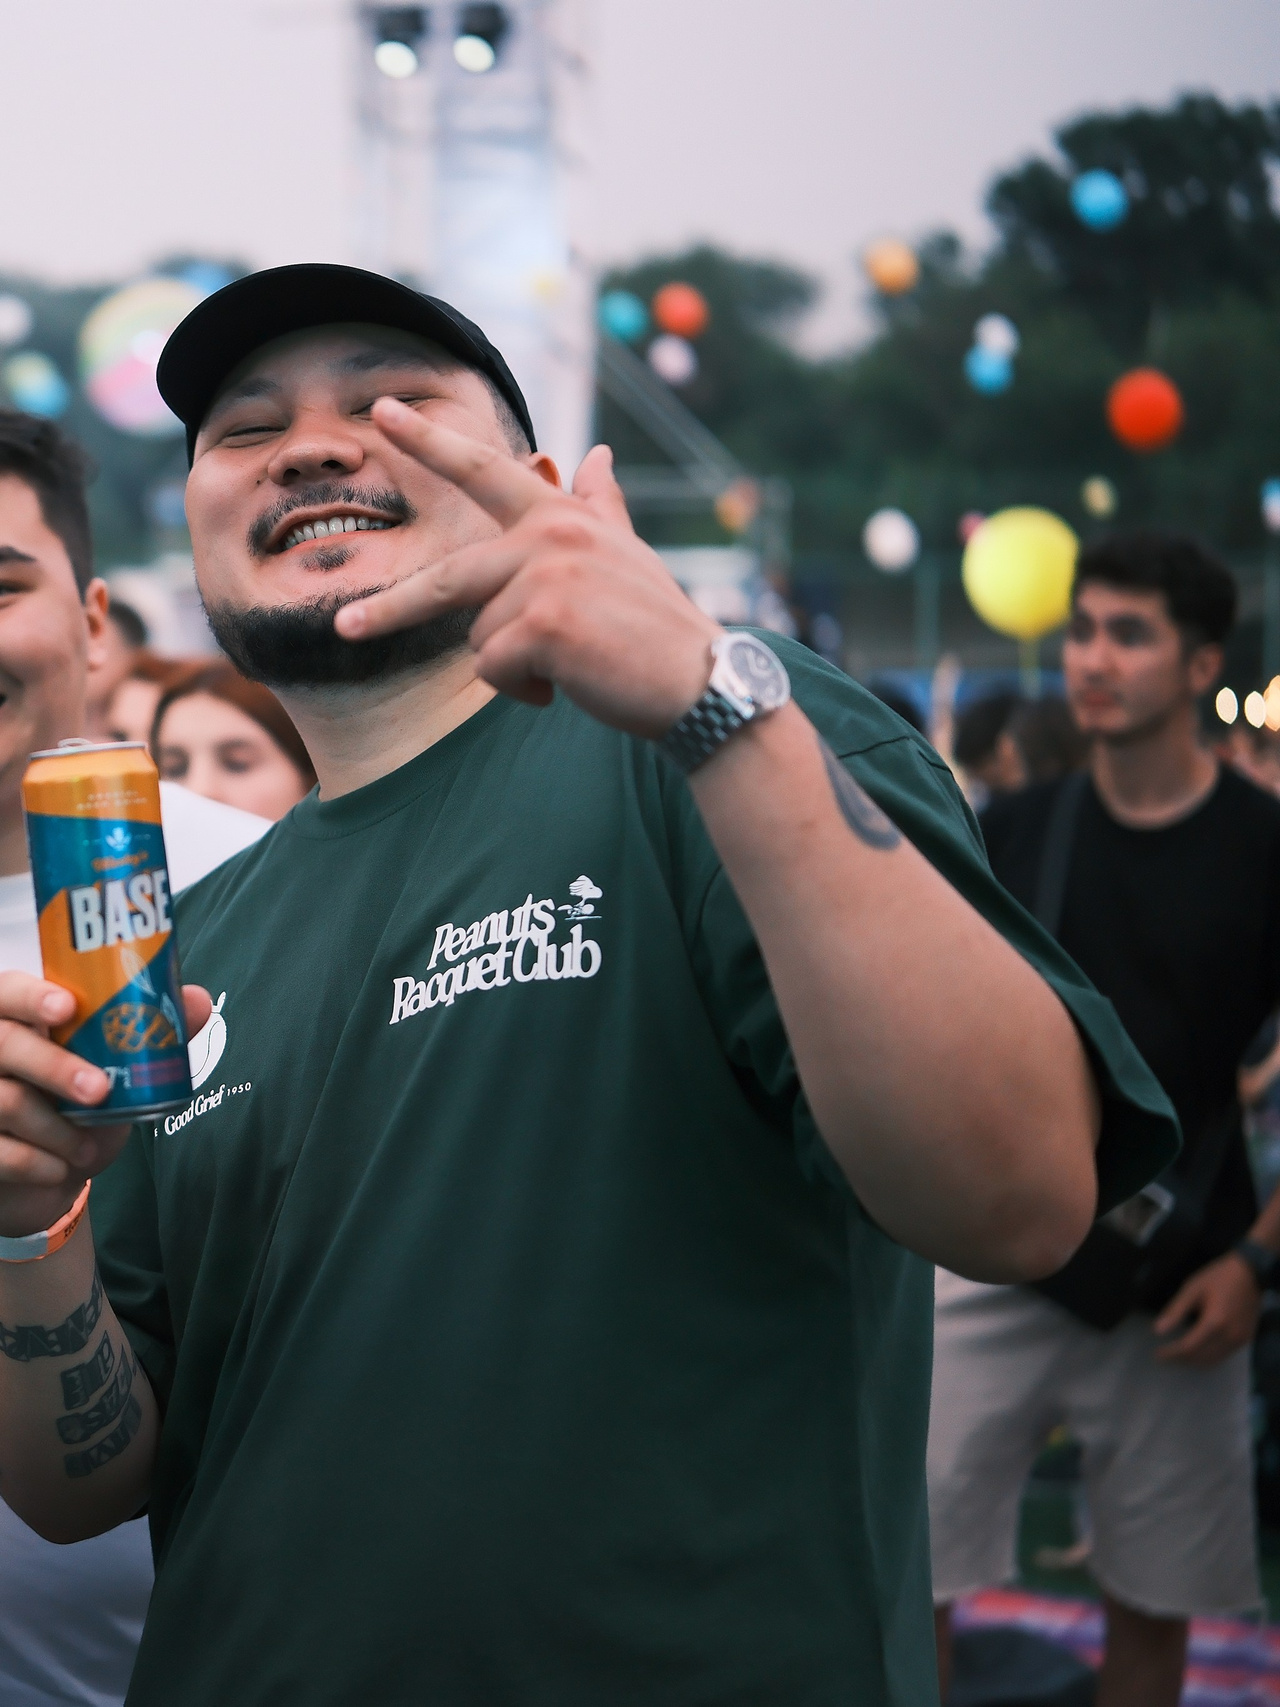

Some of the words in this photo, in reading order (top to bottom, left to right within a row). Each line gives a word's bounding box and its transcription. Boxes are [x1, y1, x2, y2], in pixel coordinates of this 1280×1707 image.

[70, 869, 173, 954] BASE
[426, 893, 556, 971] Peanuts
[389, 941, 513, 1025] Racquet
[512, 923, 602, 983] Club
[164, 1099, 195, 1136] Good
[194, 1084, 226, 1116] Grief
[227, 1082, 252, 1097] 1950
